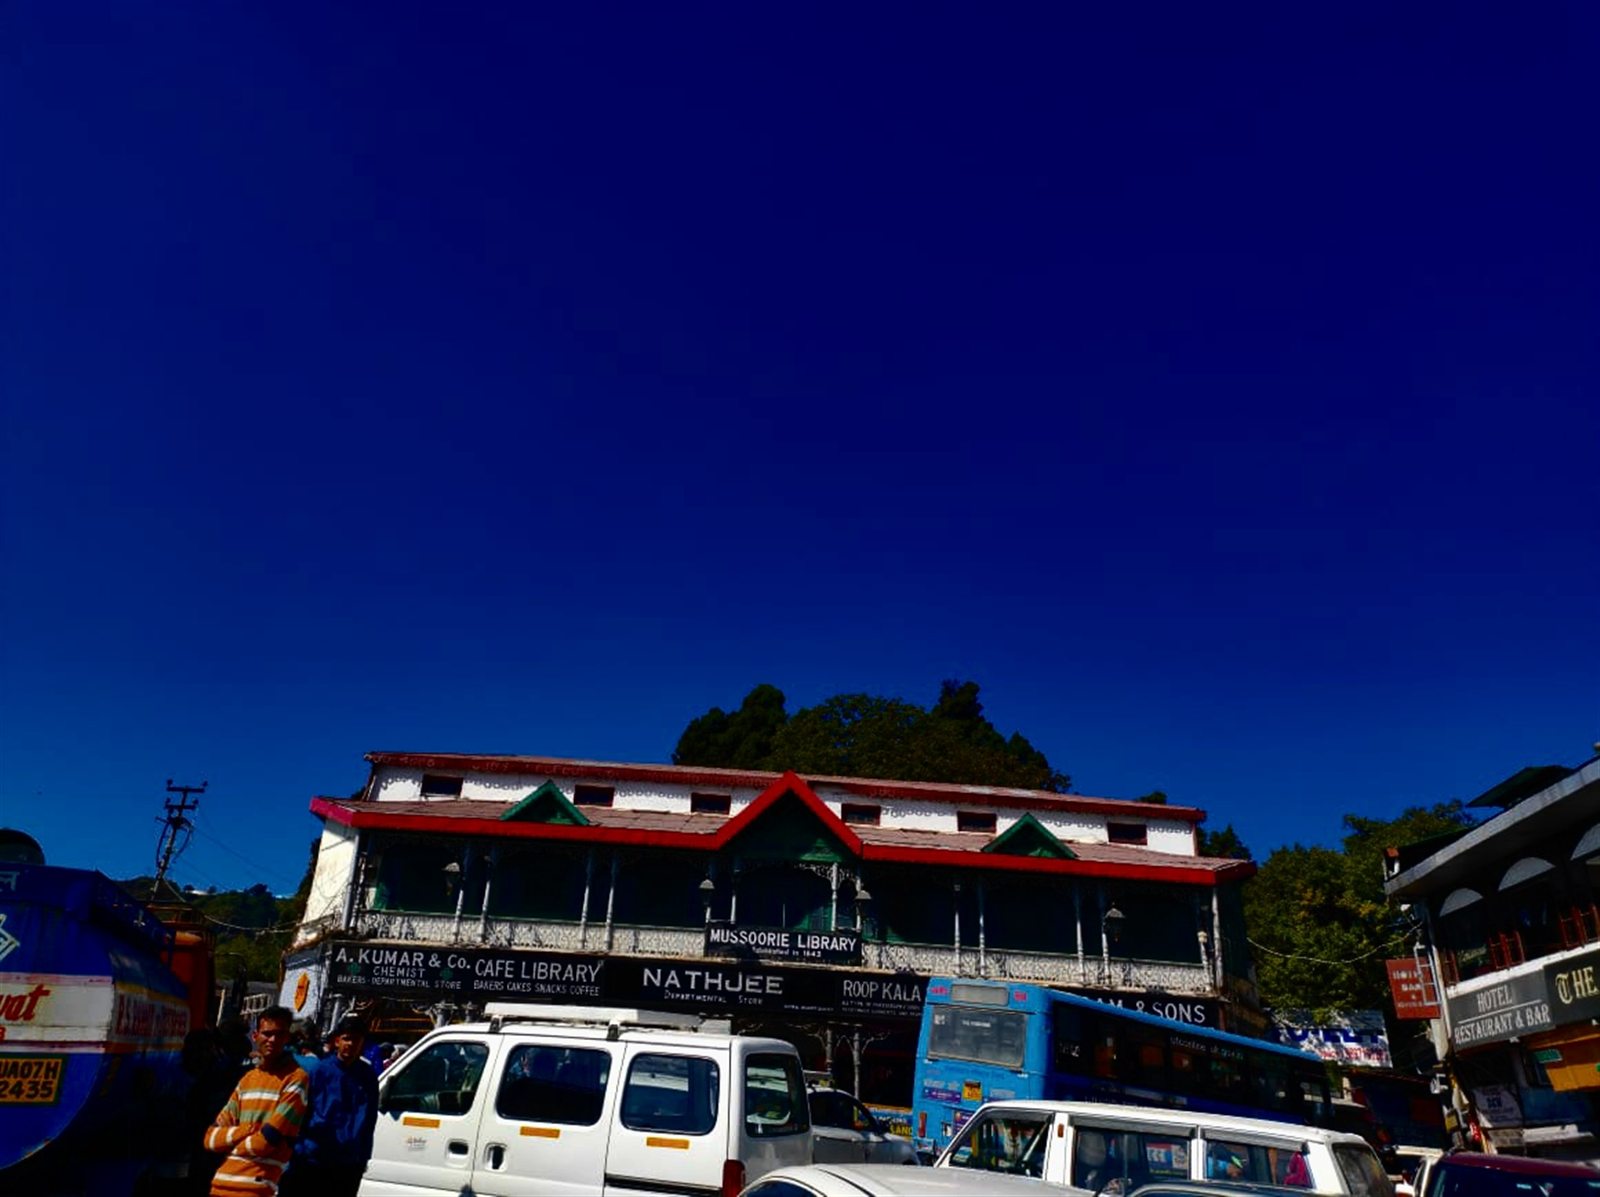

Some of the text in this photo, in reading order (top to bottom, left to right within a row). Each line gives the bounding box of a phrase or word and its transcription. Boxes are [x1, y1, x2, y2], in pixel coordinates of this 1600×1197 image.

[709, 929, 857, 952] MUSSOORIE LIBRARY
[335, 947, 471, 969] A. KUMAR & Co.
[373, 966, 426, 978] CHEMIST
[475, 958, 601, 983] CAFE LIBRARY
[642, 968, 784, 995] NATHJEE
[434, 980, 462, 989] STORE
[473, 979, 600, 996] BAKERS CAKES SNACKS COFFEE
[842, 979, 879, 998] ROOP
[881, 982, 922, 1002] KALA
[1555, 967, 1600, 1005] THE
[1477, 984, 1513, 1013] HOTEL
[1152, 1001, 1206, 1024] SONS
[1454, 1004, 1551, 1044] RESTAURANT & BAR
[0, 1080, 53, 1098] 2435
